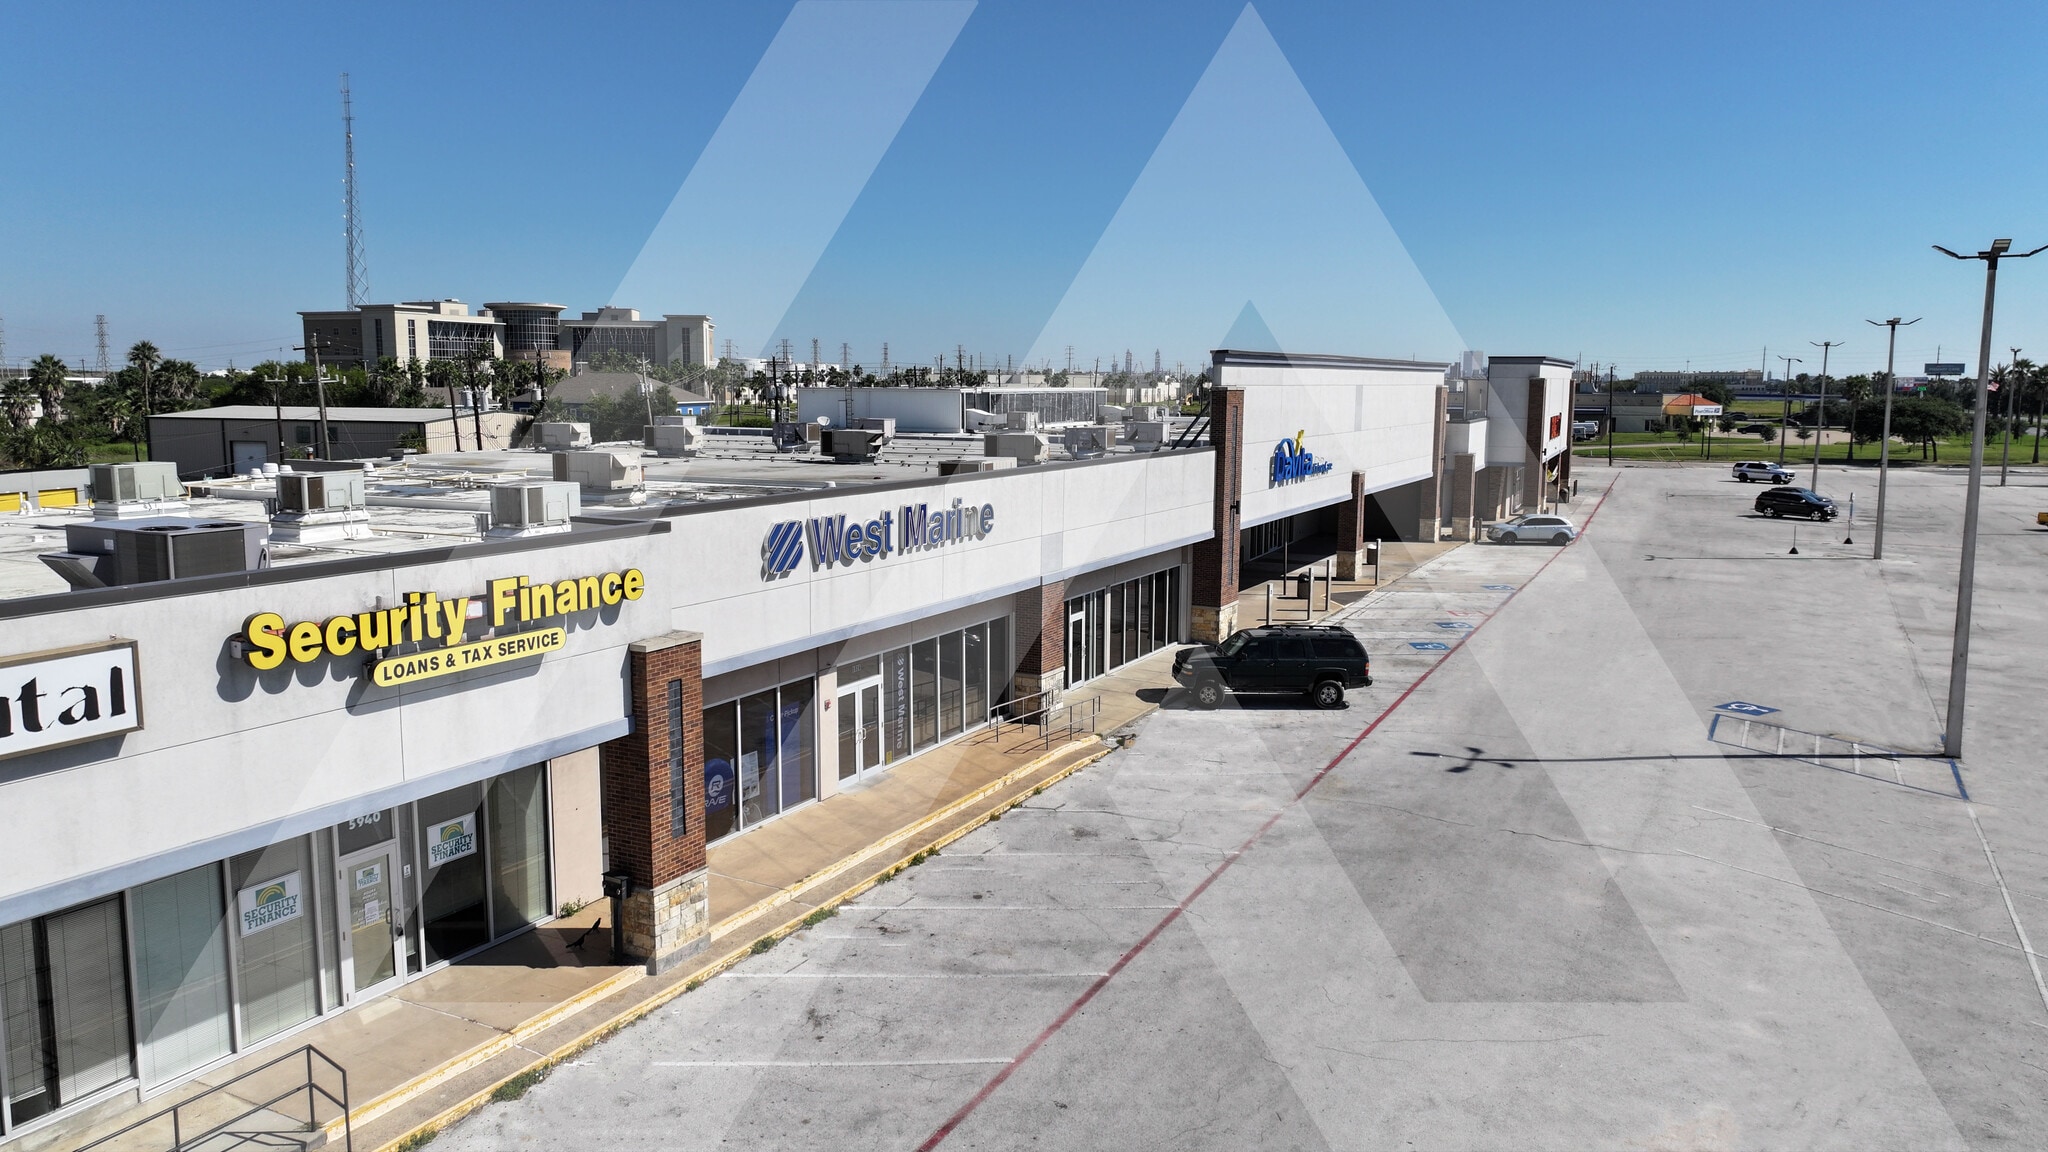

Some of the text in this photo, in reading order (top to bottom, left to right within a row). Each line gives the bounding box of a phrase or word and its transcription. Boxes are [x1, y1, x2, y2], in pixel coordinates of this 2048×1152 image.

[806, 497, 995, 565] West Marine
[243, 568, 645, 670] Security Finance
[383, 632, 560, 681] LOANS & TAX SERVICE
[348, 811, 381, 830] 5940
[431, 833, 474, 854] SECURITY
[434, 842, 472, 862] FINANCE
[244, 894, 298, 922] SECURITY
[248, 905, 297, 930] FINANCE
